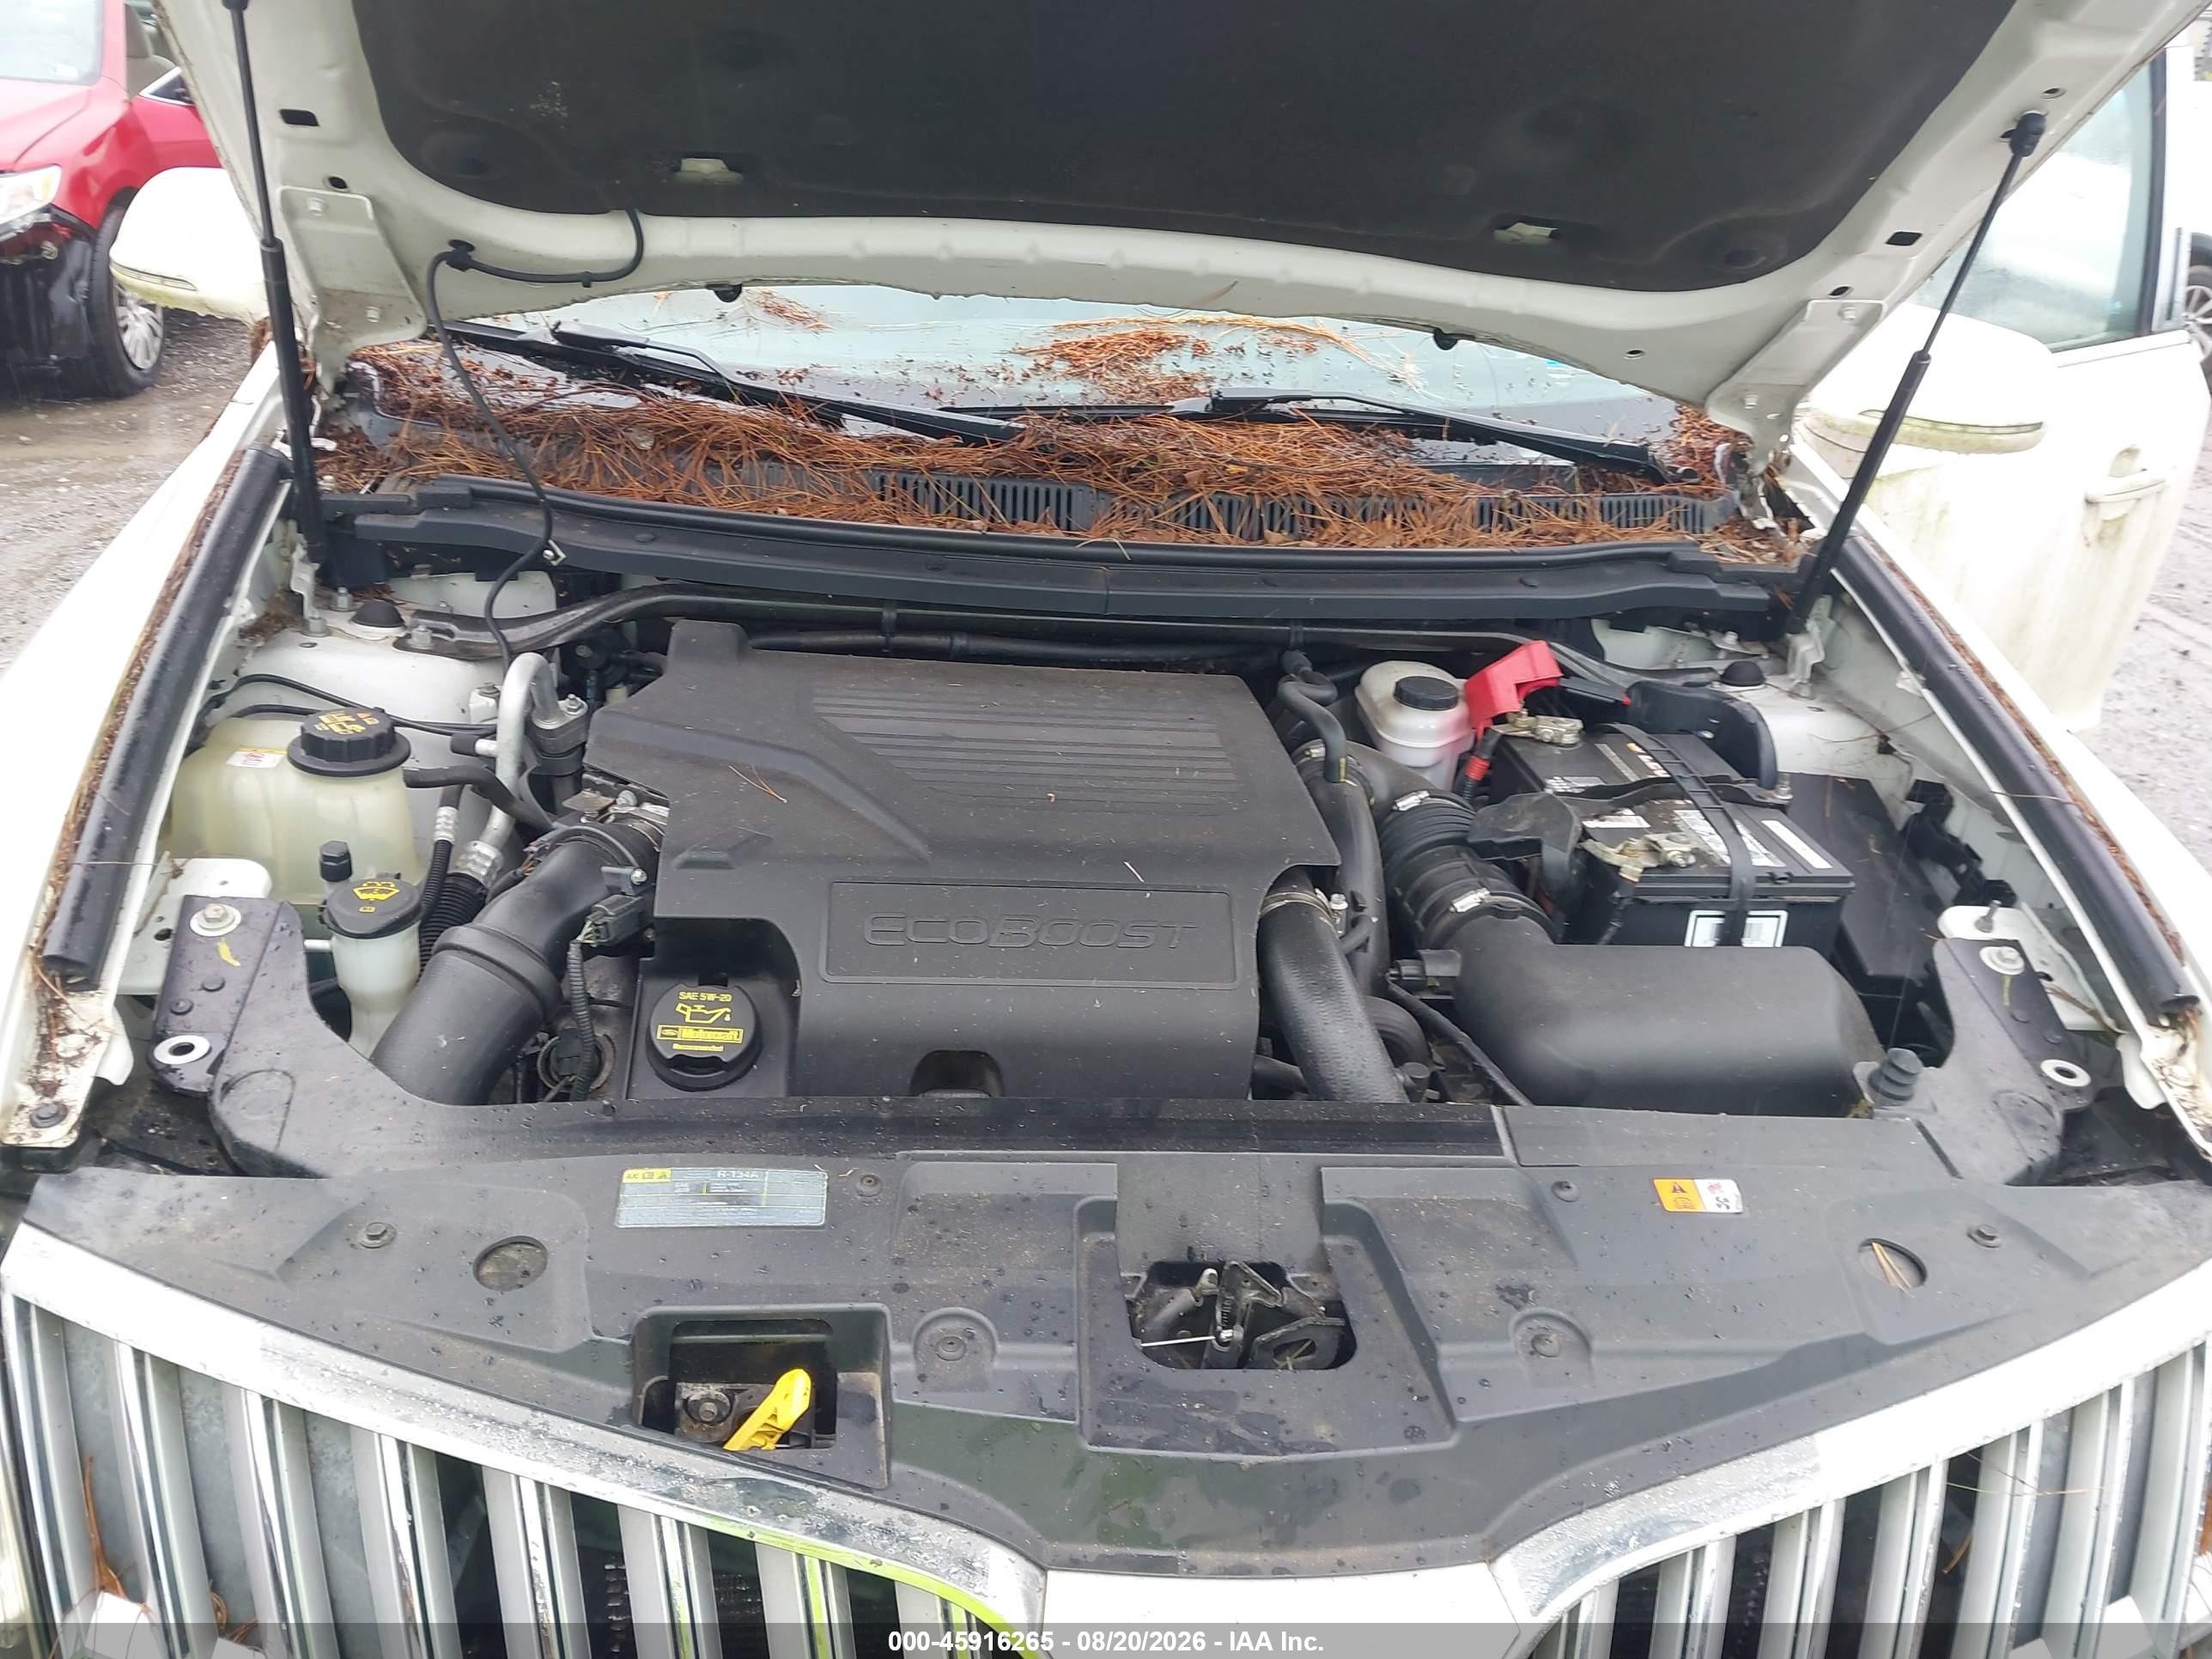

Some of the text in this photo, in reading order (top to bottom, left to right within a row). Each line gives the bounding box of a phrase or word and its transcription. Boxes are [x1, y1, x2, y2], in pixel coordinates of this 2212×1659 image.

[678, 991, 732, 1002] SAE 5W-20
[716, 1170, 759, 1179] R-134A
